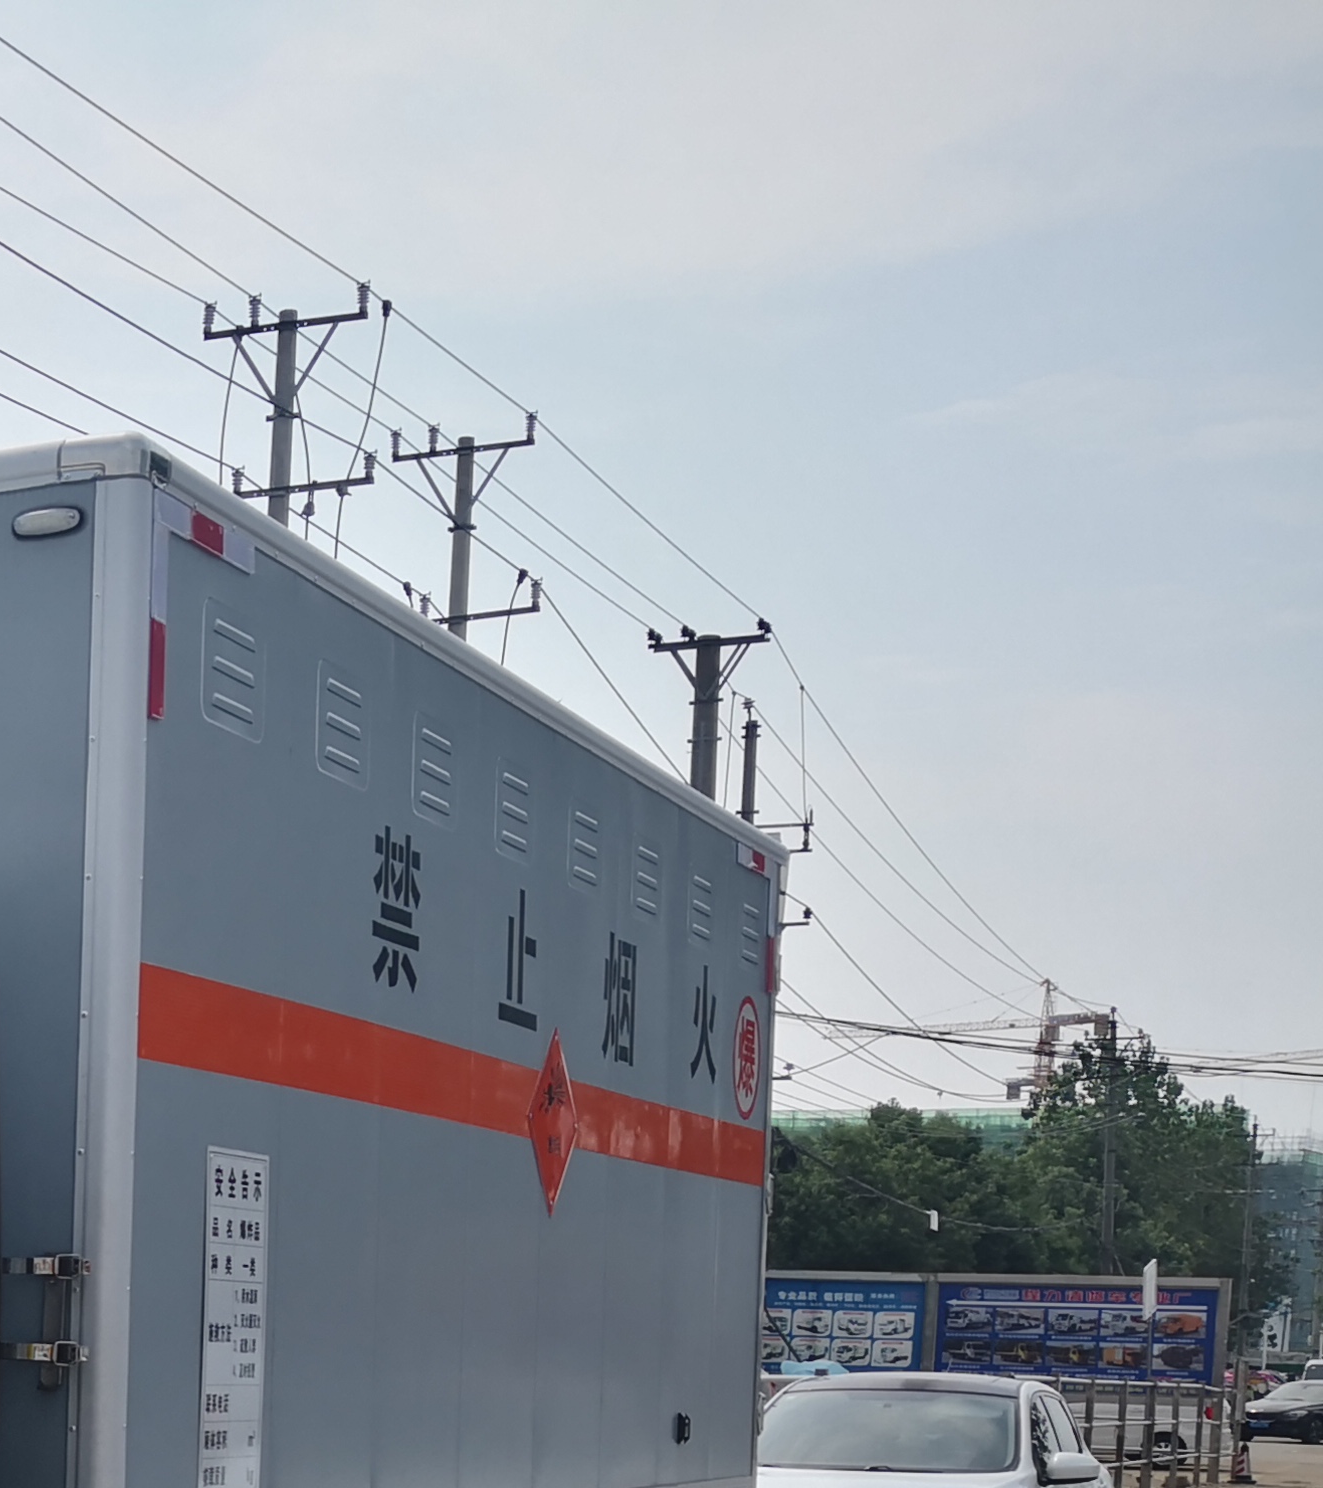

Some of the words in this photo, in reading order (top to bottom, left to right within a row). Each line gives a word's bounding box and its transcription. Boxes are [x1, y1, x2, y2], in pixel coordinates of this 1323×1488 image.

[371, 825, 717, 1084] 禁止烟火
[214, 1164, 262, 1202] 安全告示
